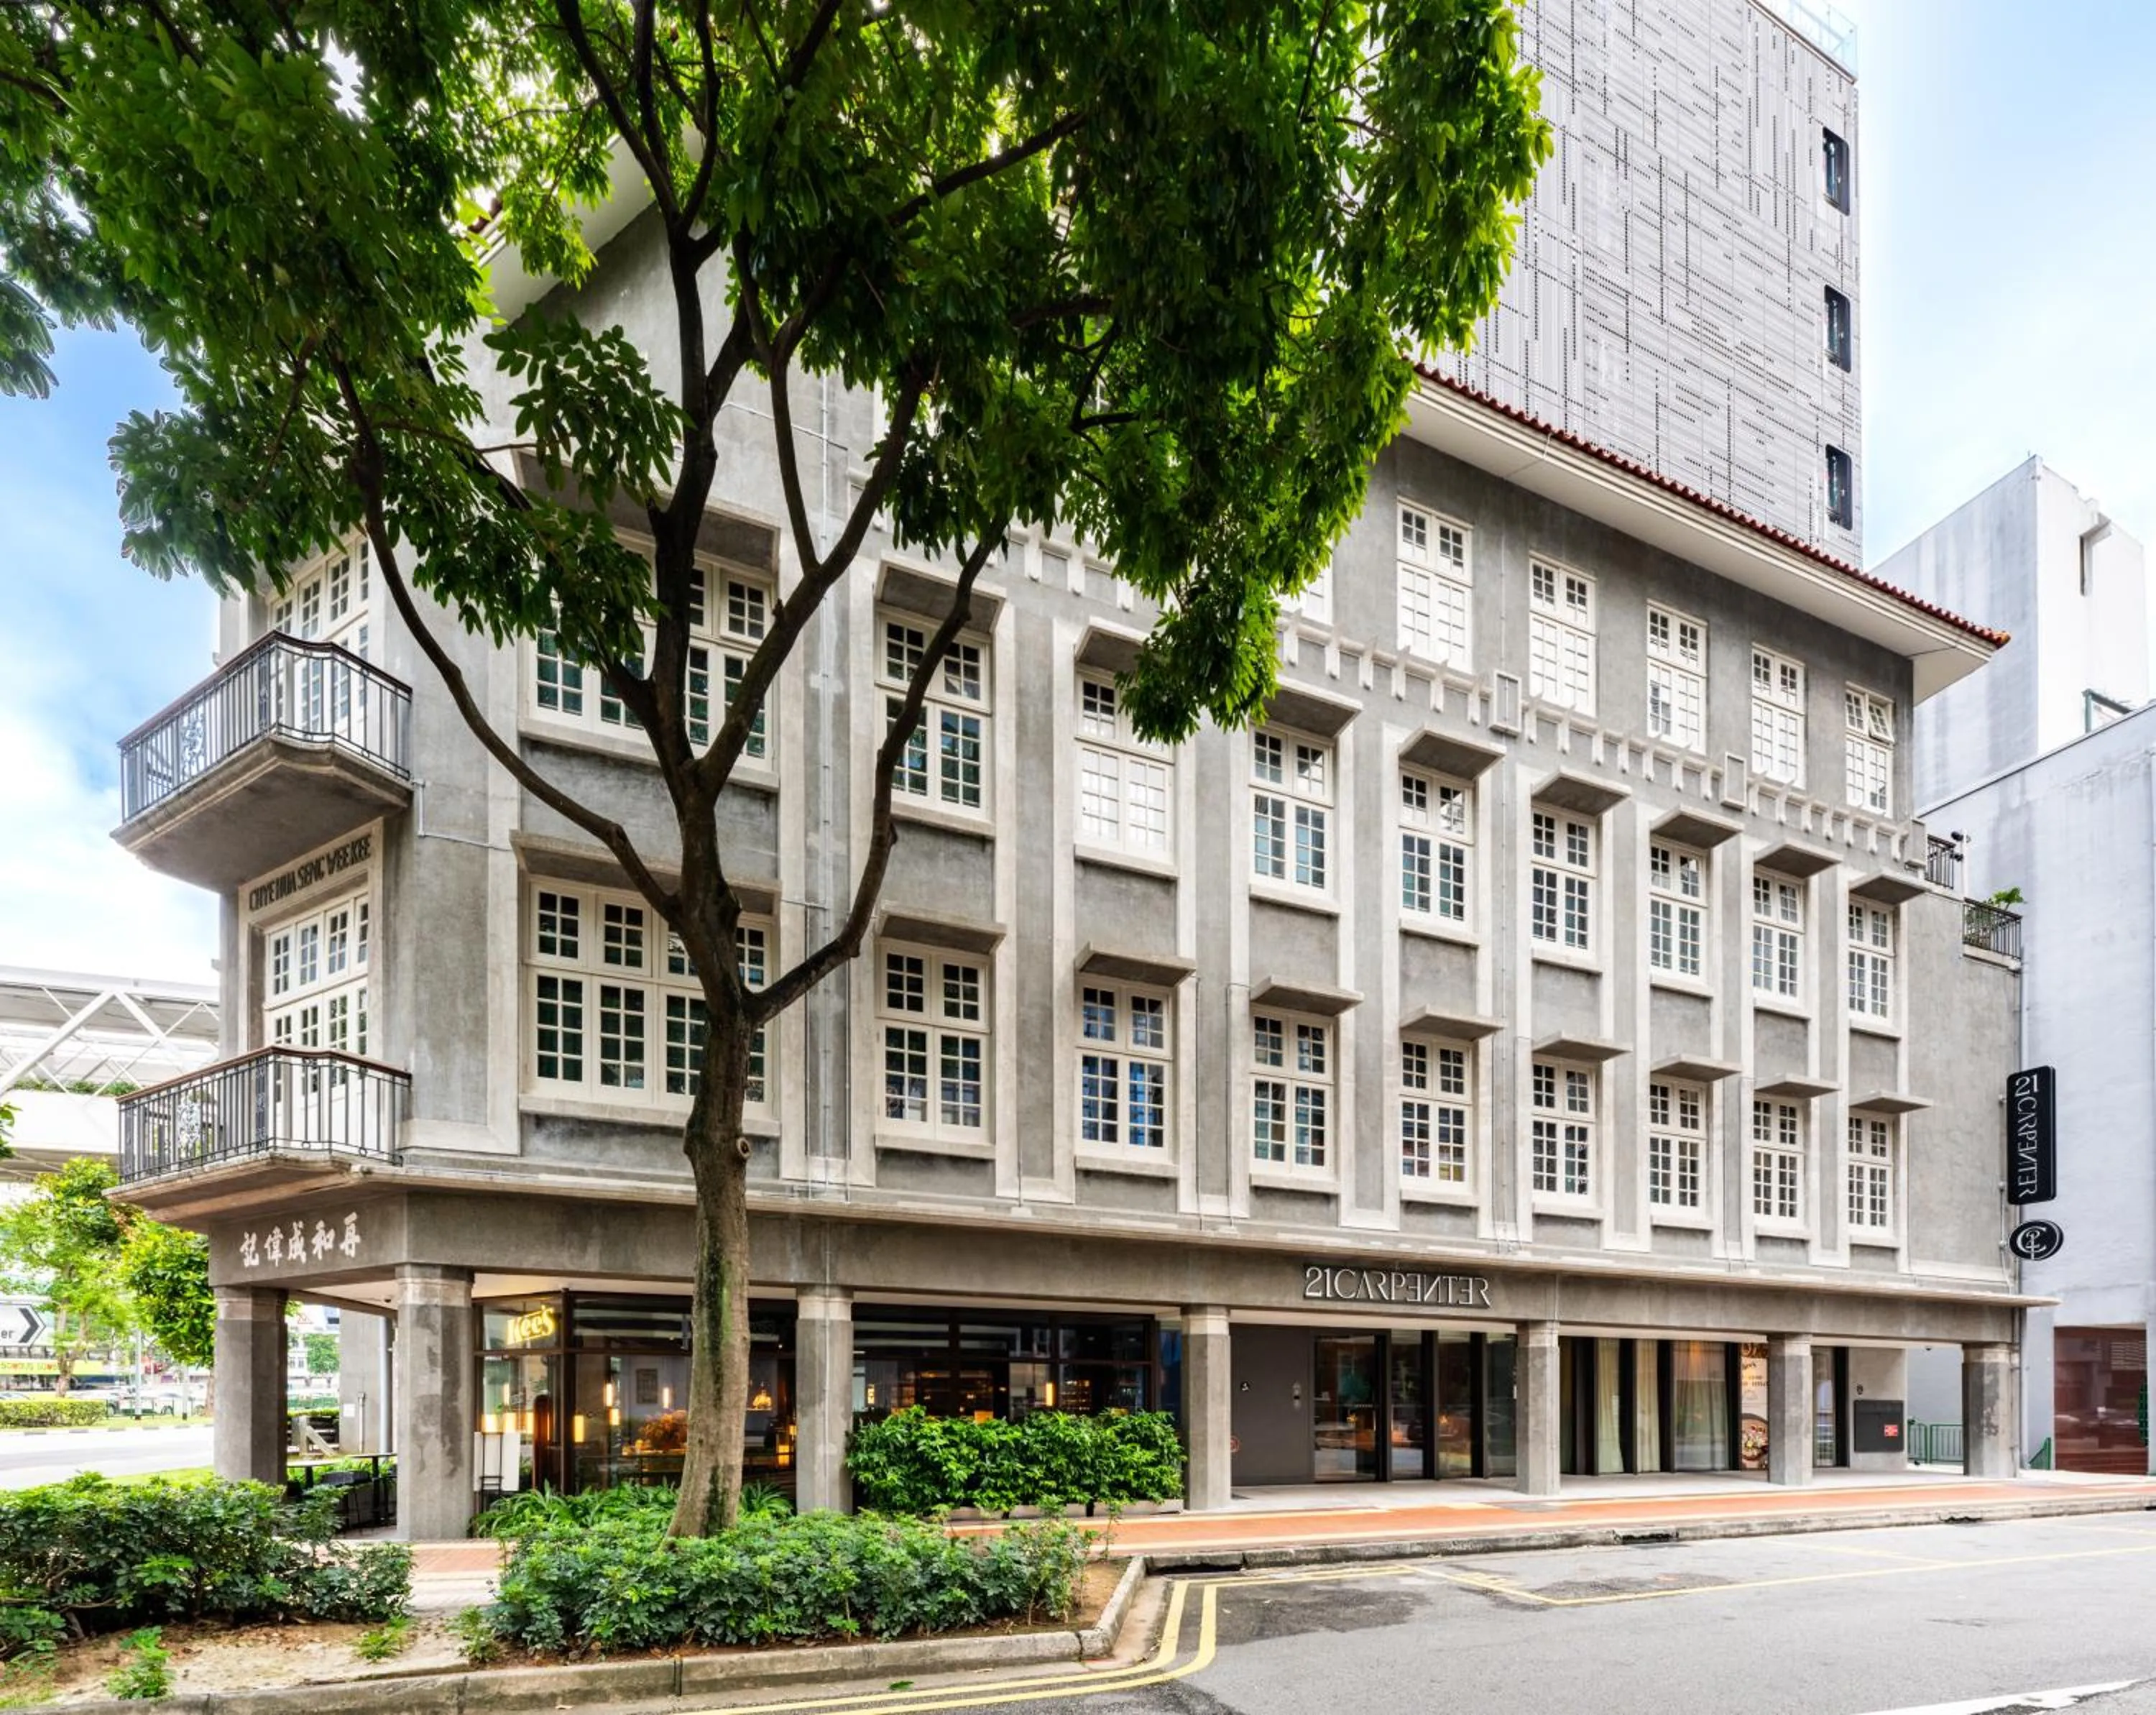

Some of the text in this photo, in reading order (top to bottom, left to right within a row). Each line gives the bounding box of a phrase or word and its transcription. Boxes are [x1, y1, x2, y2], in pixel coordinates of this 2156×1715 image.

[249, 833, 371, 911] CHYE HUA SENG WEE KEE
